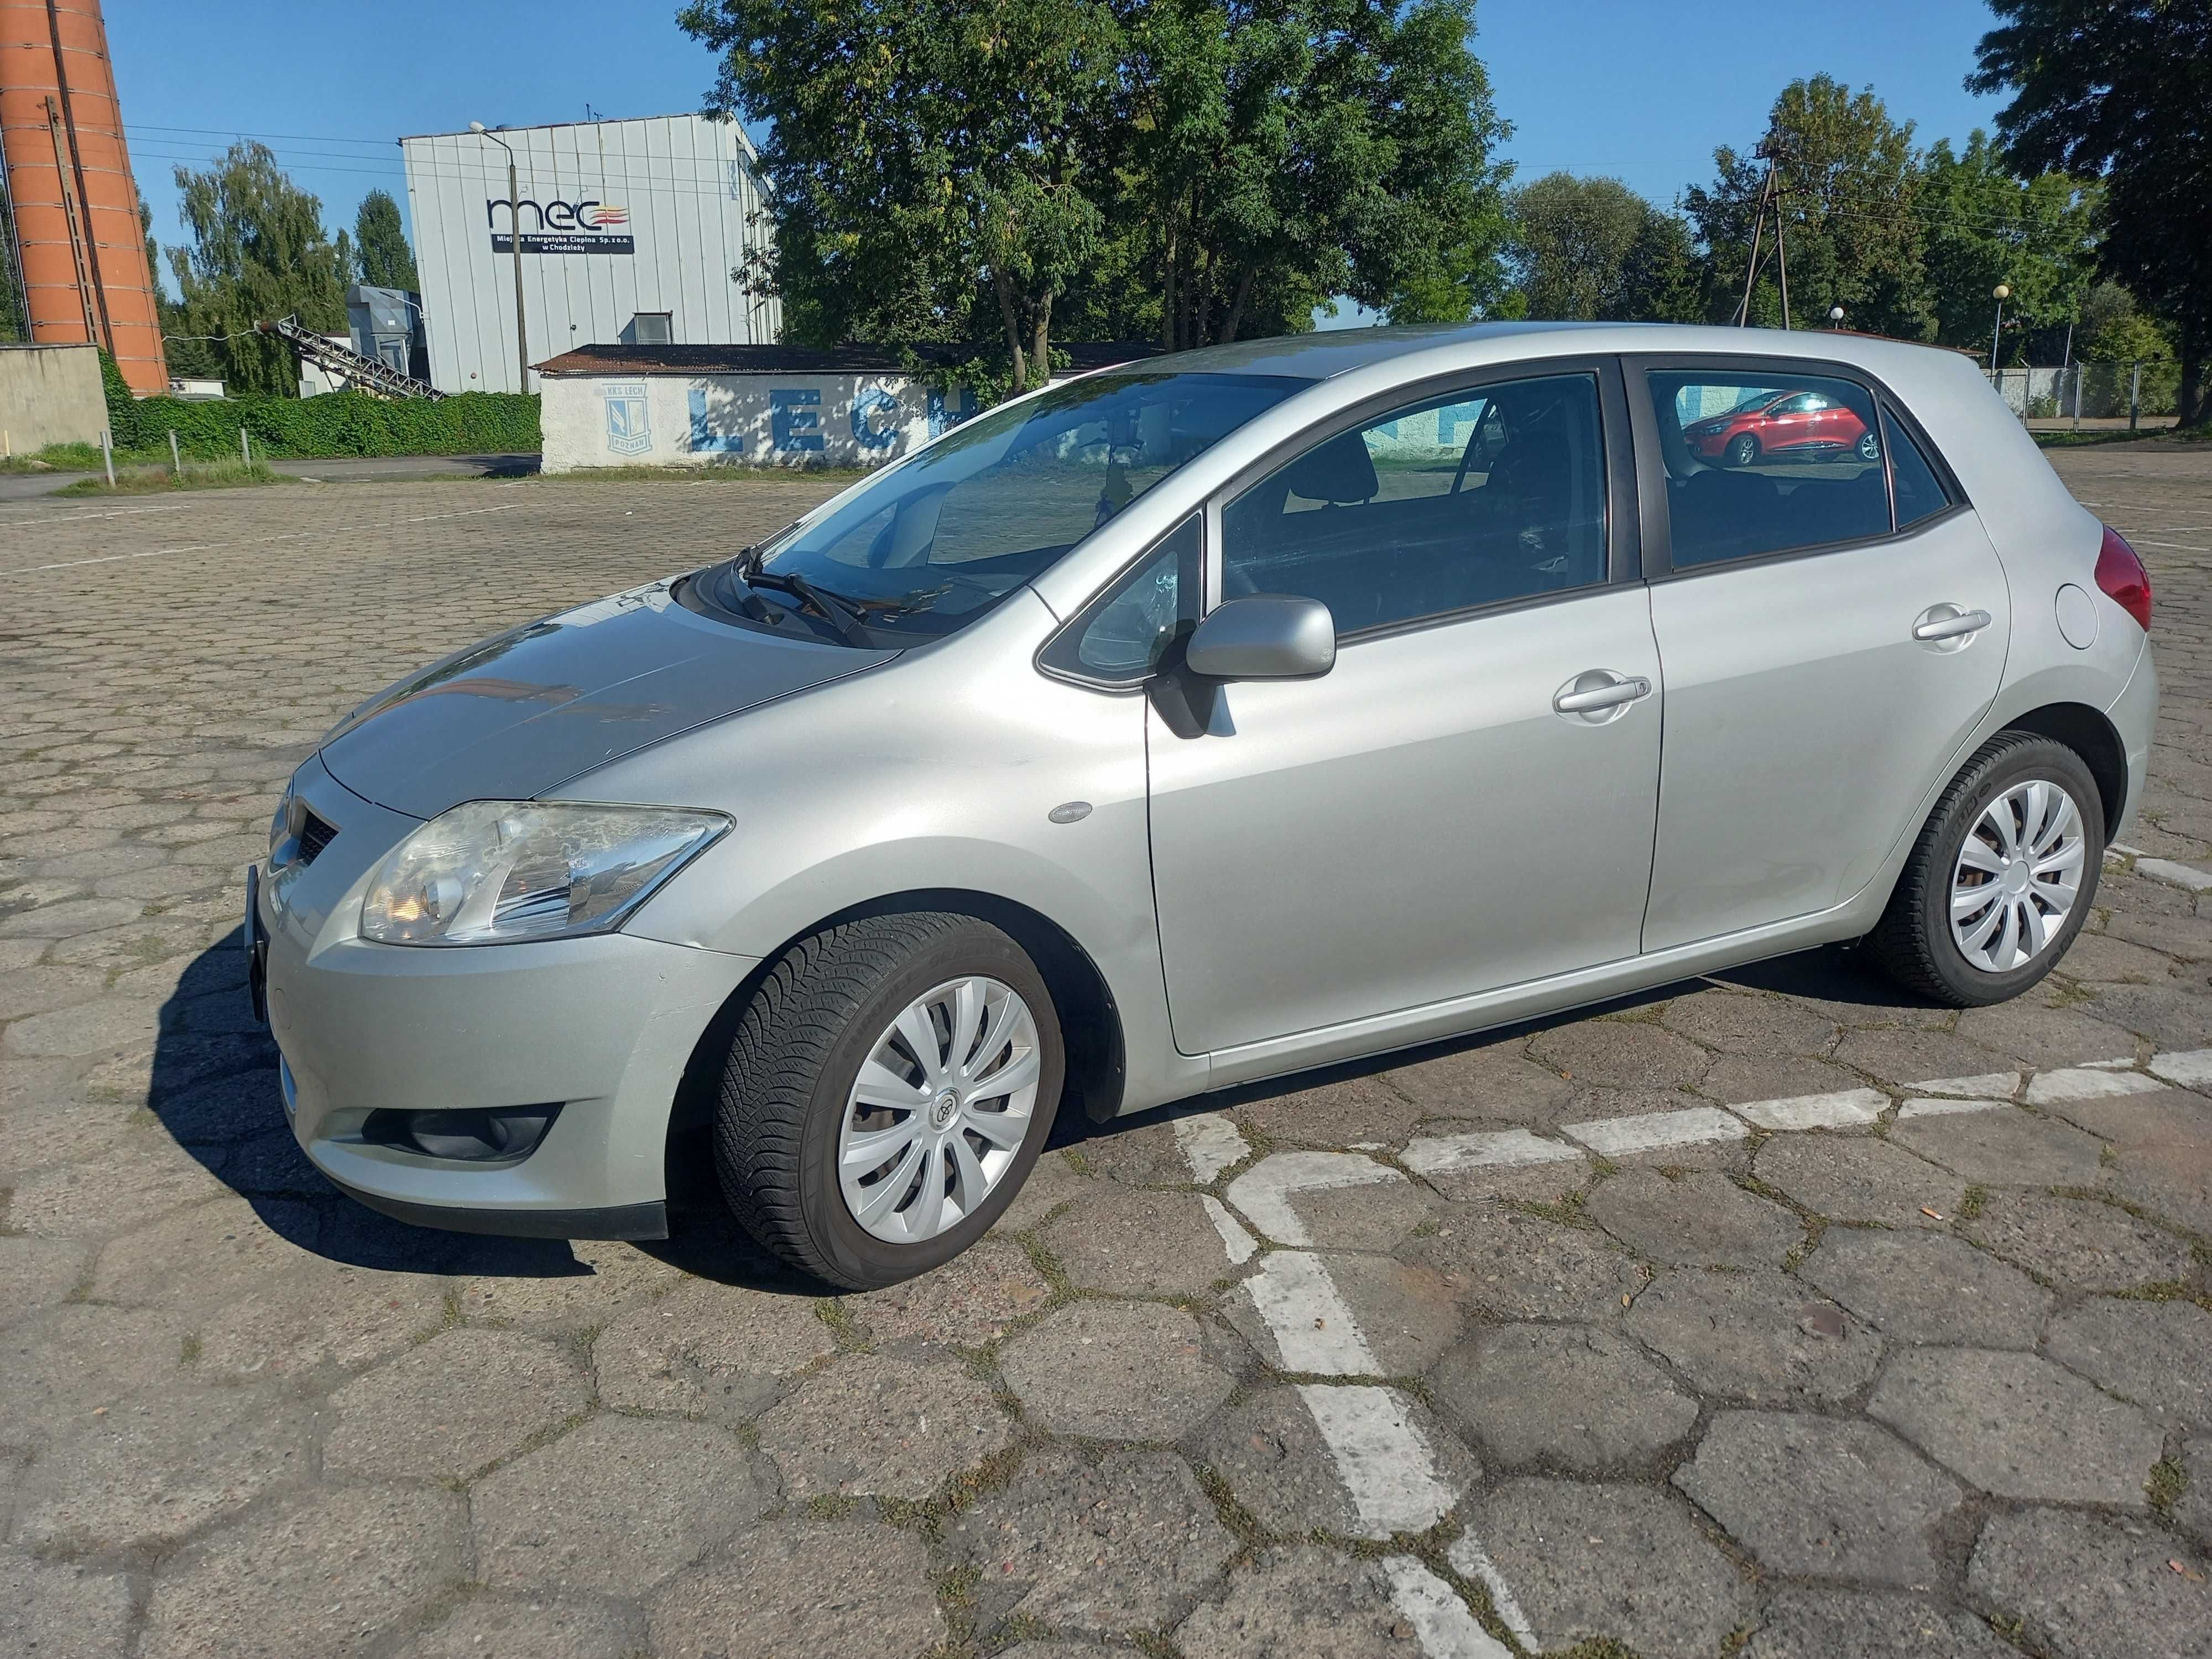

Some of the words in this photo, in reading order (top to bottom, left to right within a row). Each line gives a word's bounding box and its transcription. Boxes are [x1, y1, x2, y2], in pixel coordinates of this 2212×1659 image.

[487, 199, 602, 231] mec
[607, 387, 622, 395] KKS
[625, 387, 643, 395] LECH
